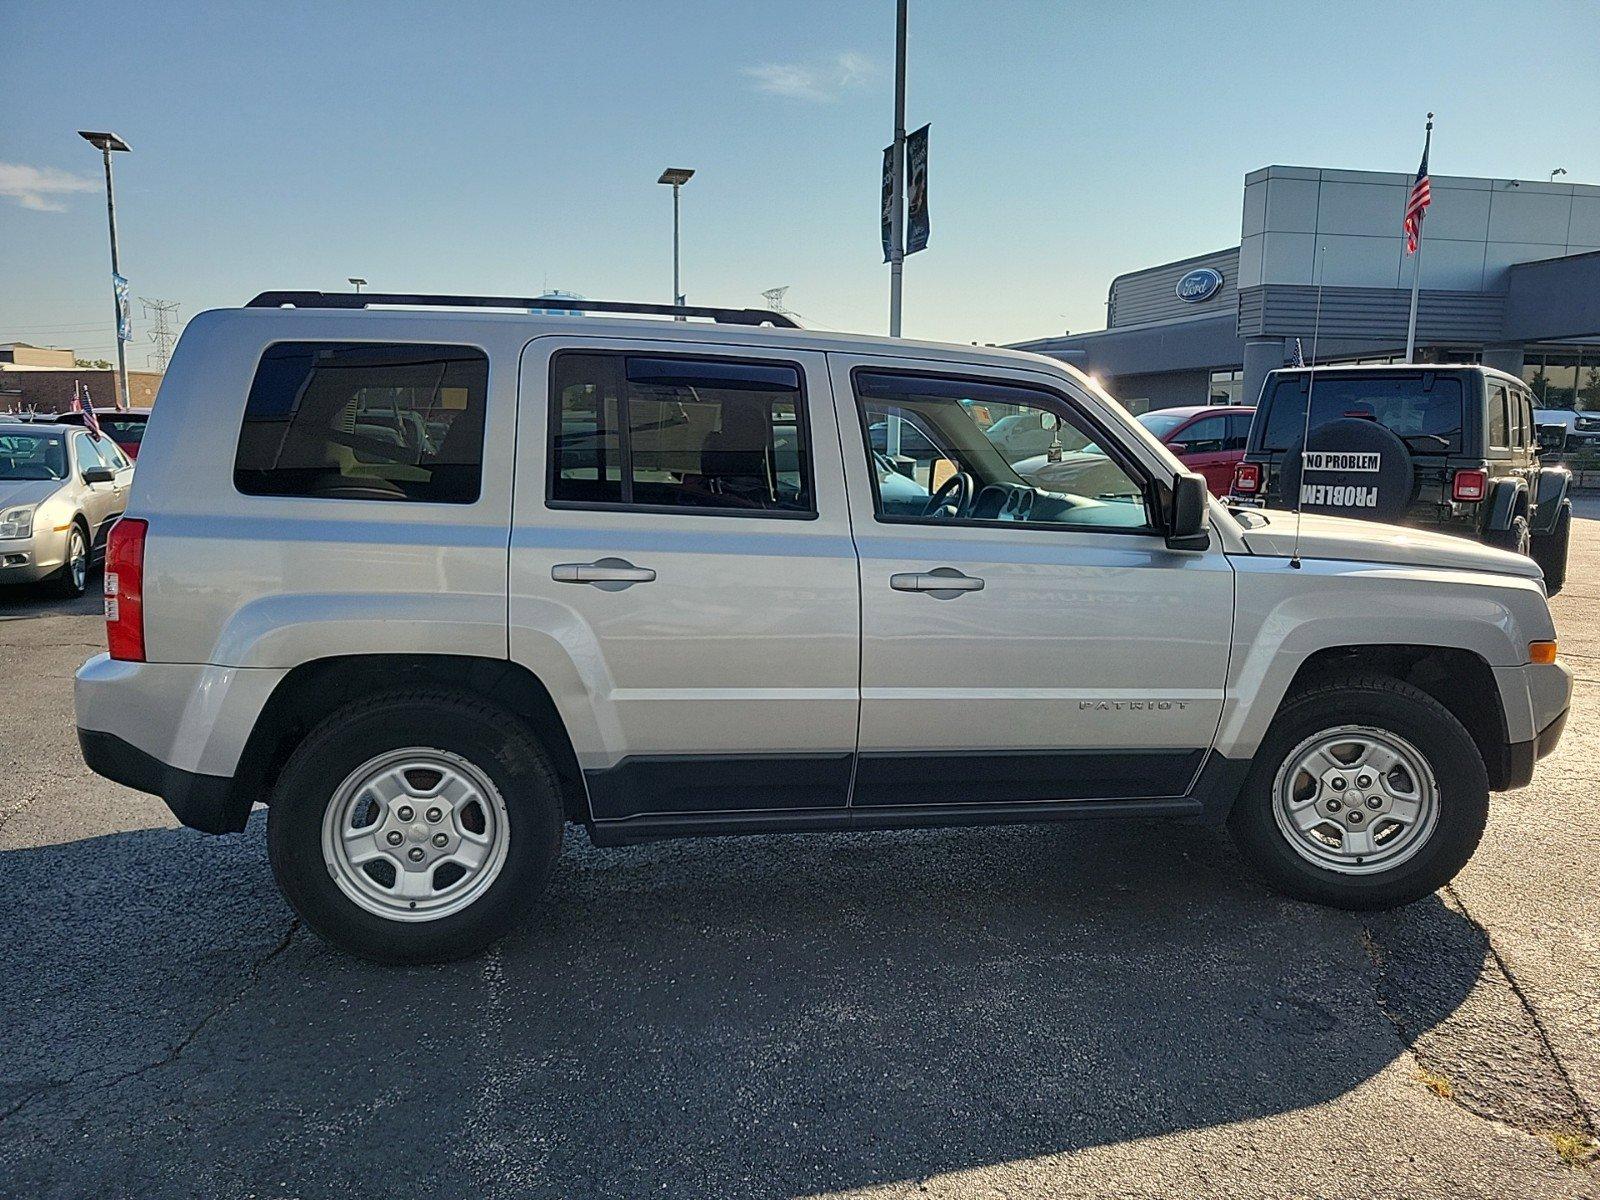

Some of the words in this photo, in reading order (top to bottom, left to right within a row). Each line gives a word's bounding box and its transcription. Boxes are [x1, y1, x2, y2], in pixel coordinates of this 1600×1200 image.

[1182, 276, 1208, 296] Ford
[1307, 454, 1322, 468] NO
[1325, 455, 1378, 469] PROBLEM
[1301, 485, 1378, 507] PROBLEM
[1079, 700, 1190, 711] PATRIOT
